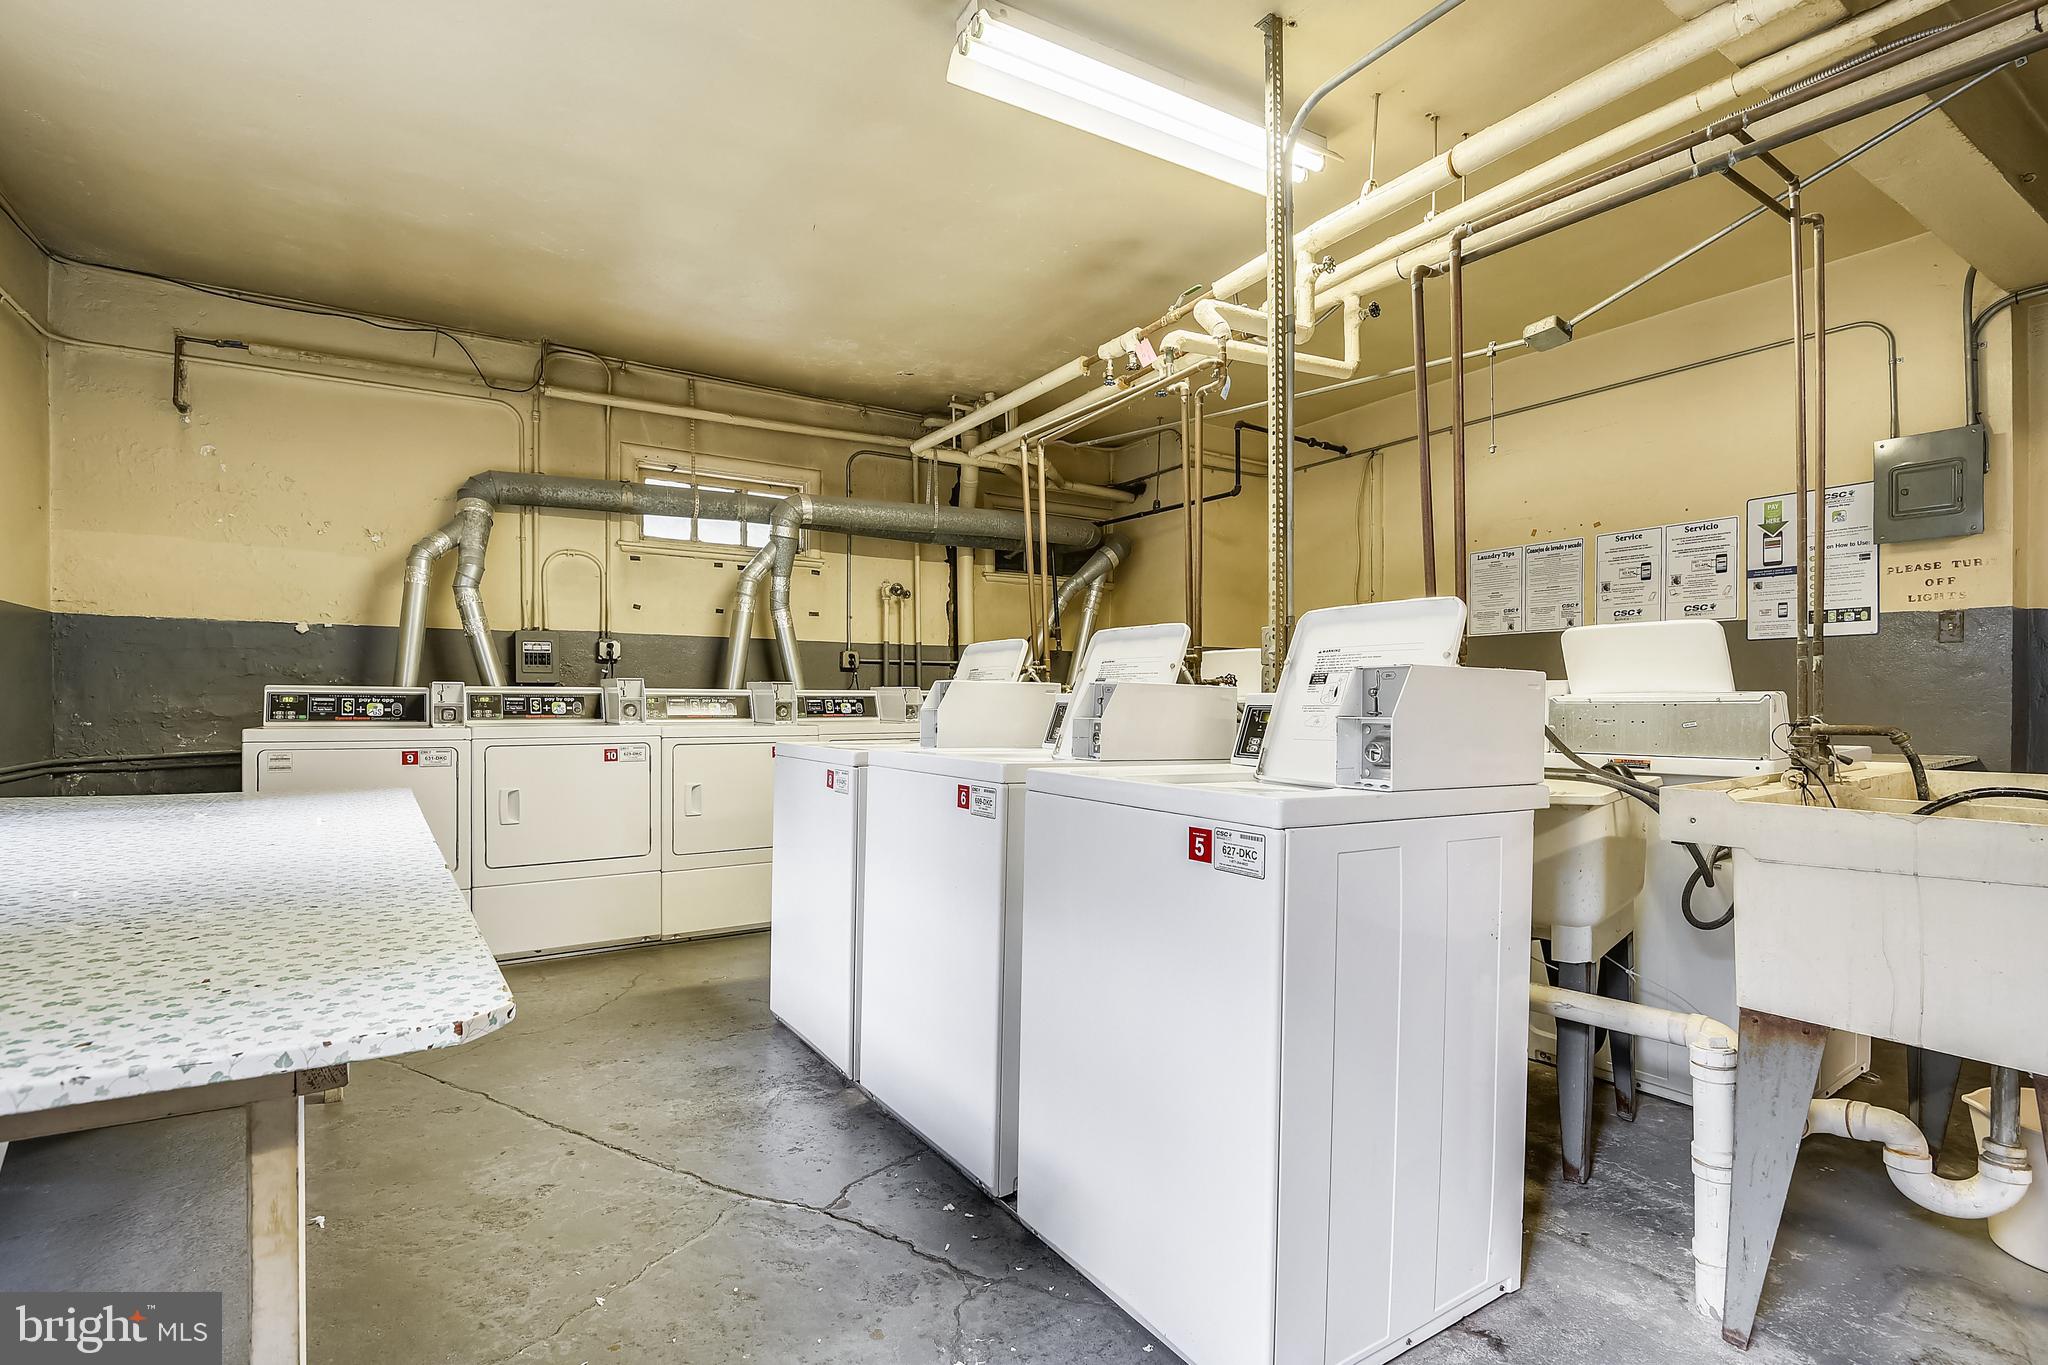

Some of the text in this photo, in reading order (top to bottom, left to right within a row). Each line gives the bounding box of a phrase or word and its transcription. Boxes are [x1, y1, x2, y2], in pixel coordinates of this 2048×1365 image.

[1767, 503, 1779, 511] PAY
[1765, 517, 1781, 525] HERE
[1684, 523, 1719, 533] Servicio
[1615, 533, 1643, 543] Service
[1526, 547, 1545, 555] Consejos
[1568, 541, 1582, 549] secado
[1835, 541, 1848, 549] How
[1477, 550, 1515, 562] Laundry Tips
[1887, 558, 1991, 575] PLEASE TUR
[1925, 576, 1956, 587] OFF
[1613, 608, 1636, 617] CSC
[1683, 603, 1709, 612] CSC
[406, 754, 414, 764] 9
[605, 751, 617, 760] 10
[960, 791, 966, 805] 6
[1215, 830, 1229, 838] CSC
[1194, 837, 1205, 856] 5
[1222, 845, 1258, 861] 627-DKC
